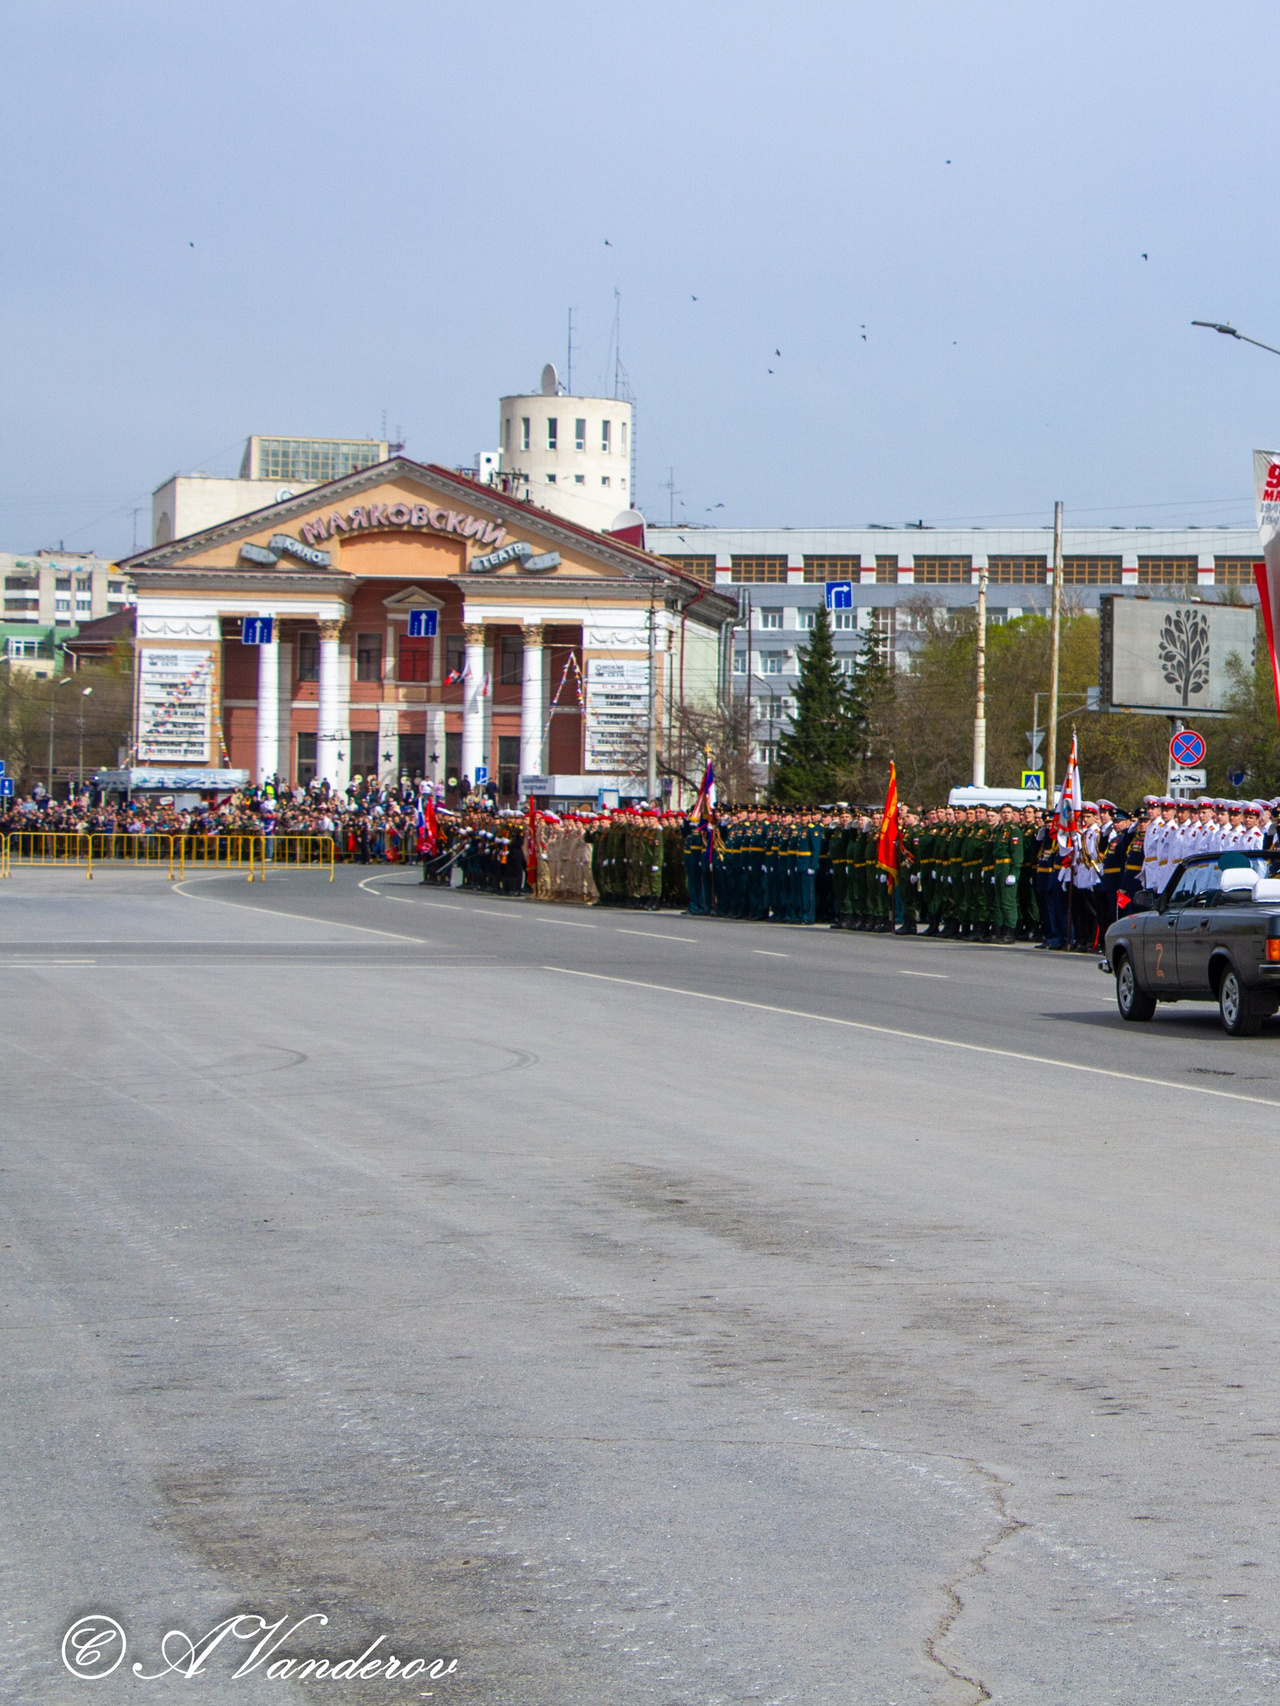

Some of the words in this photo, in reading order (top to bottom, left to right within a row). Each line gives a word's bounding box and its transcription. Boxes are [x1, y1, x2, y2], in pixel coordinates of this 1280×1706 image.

[300, 503, 508, 548] МАЯКОВСКИЙ
[284, 538, 322, 563] КИНО
[480, 543, 523, 568] ТЕАТР
